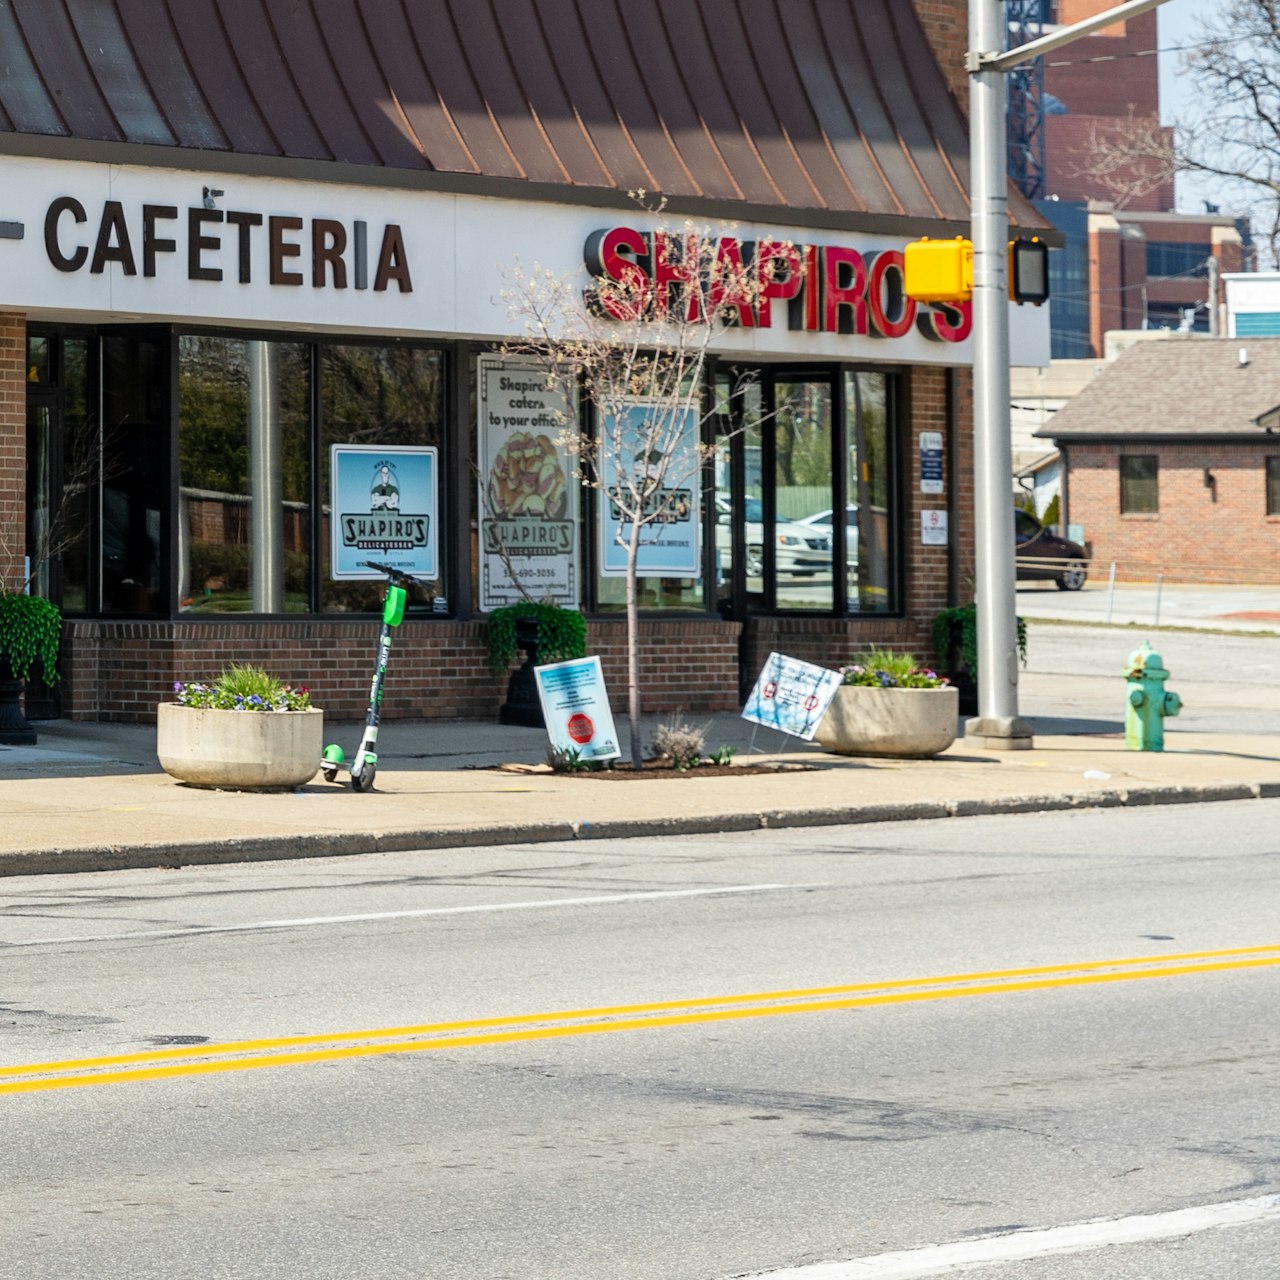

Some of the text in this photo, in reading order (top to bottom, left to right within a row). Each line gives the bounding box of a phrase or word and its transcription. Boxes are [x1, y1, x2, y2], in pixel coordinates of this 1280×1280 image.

[43, 195, 413, 294] CAFETERIA
[583, 226, 974, 343] SHAPIRO
[509, 396, 545, 409] caters
[489, 411, 565, 429] to your offic
[345, 518, 425, 543] SHAPIRO'S
[488, 523, 569, 548] SHAPIRO'S
